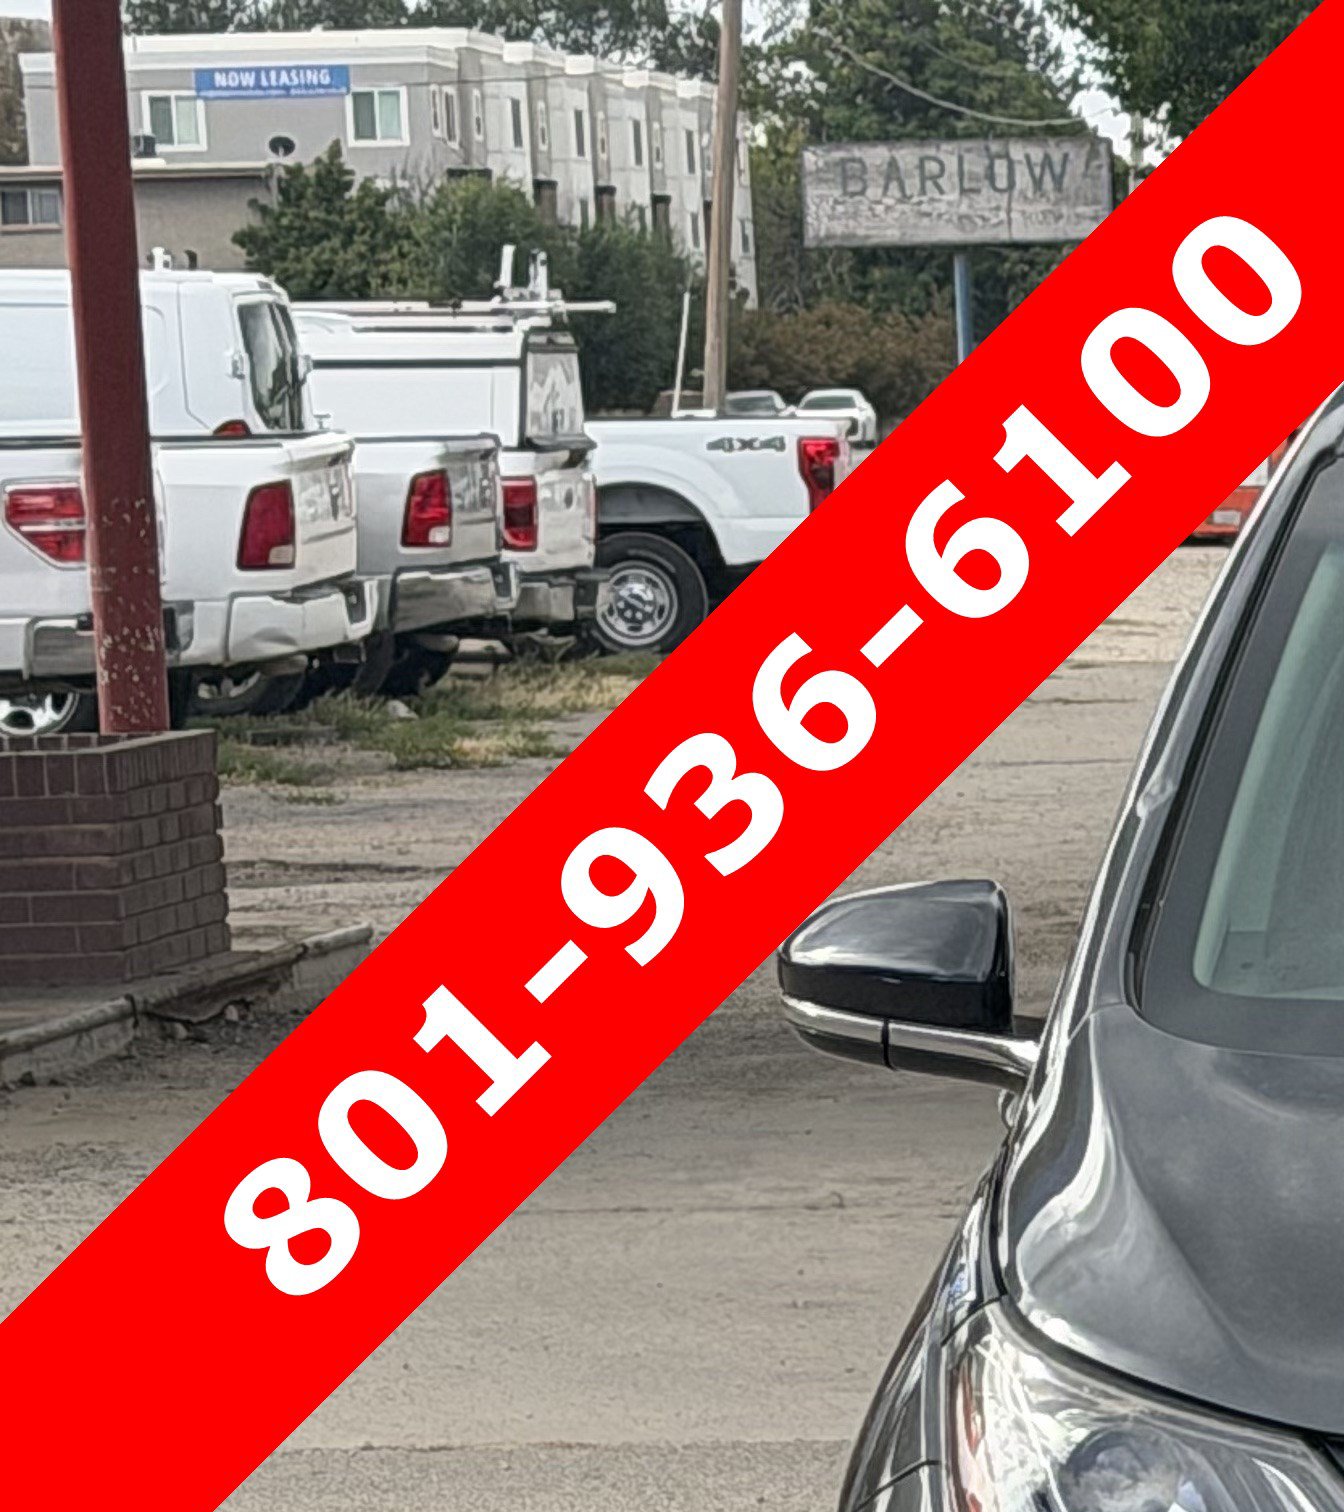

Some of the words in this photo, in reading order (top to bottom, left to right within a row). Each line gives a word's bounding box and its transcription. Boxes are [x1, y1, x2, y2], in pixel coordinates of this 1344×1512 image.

[214, 70, 255, 88] NOW
[260, 68, 331, 87] LEASING
[840, 151, 1069, 199] BARLOW
